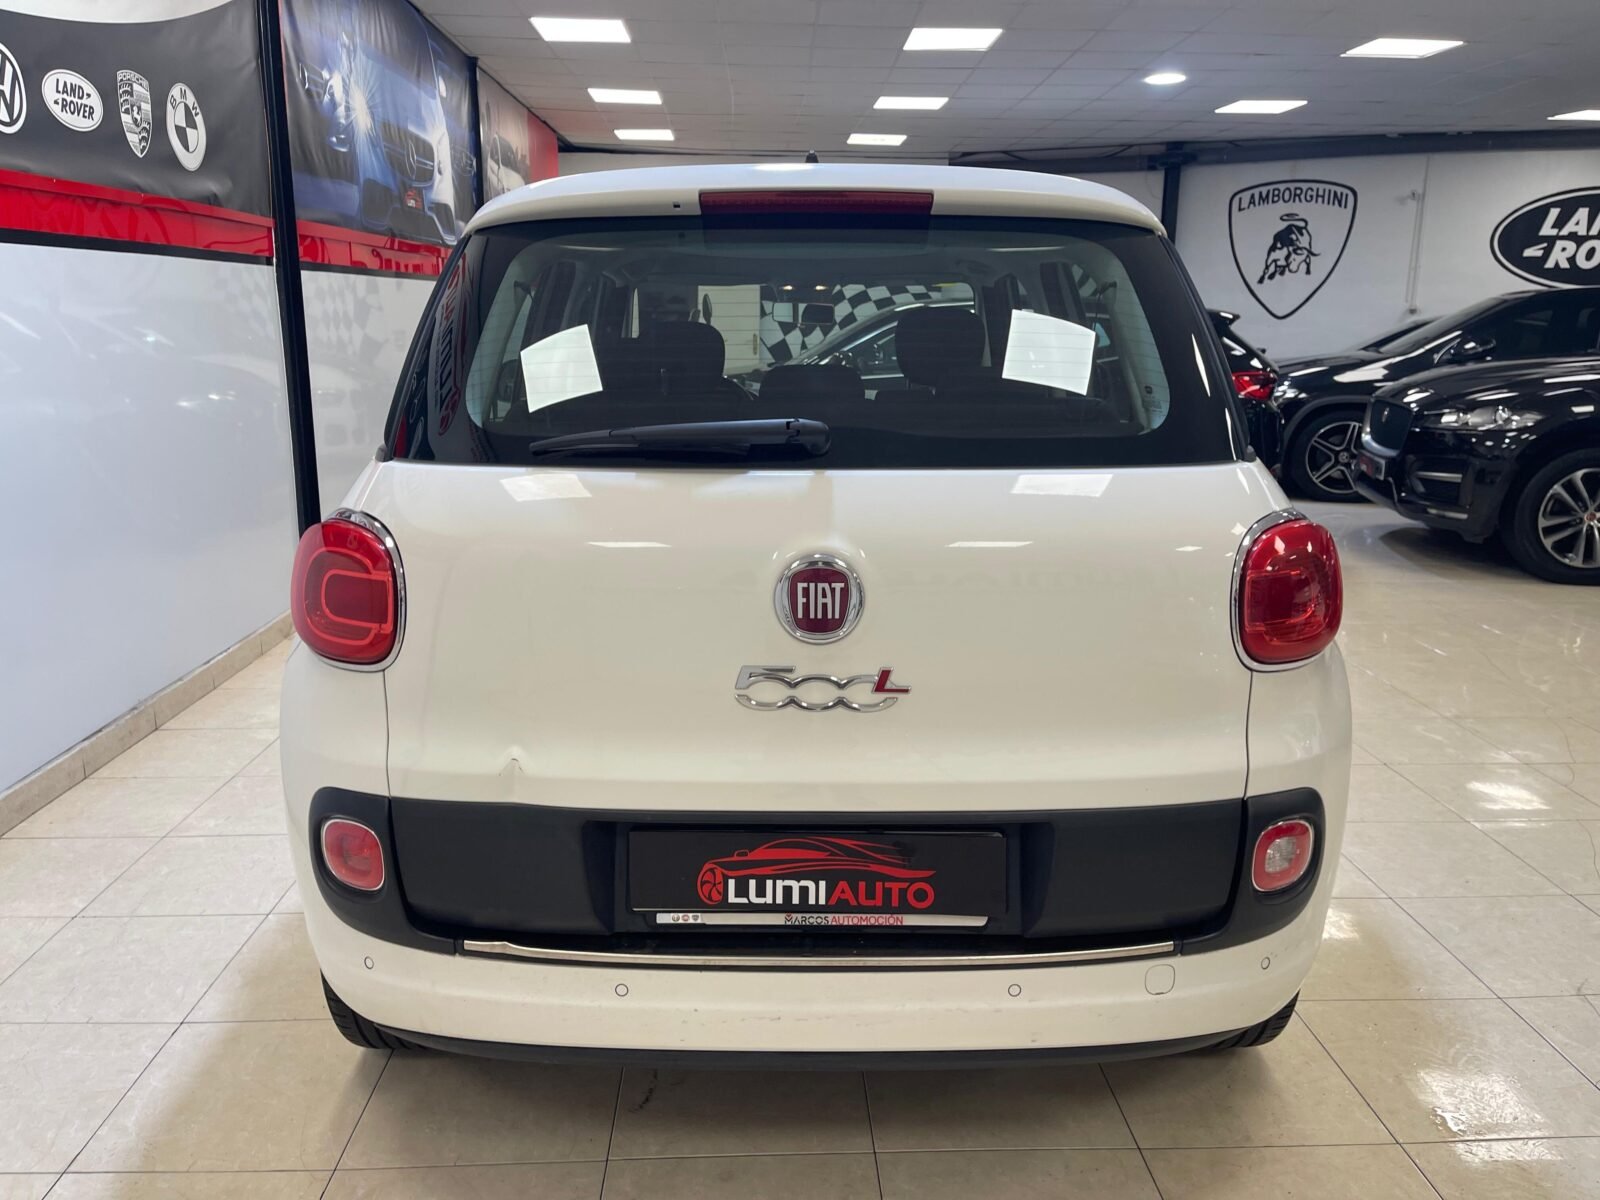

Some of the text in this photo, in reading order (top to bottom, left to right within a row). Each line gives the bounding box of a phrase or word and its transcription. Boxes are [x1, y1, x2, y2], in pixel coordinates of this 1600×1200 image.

[55, 78, 85, 101] LAND
[61, 101, 95, 121] ROVER
[169, 87, 200, 118] BMW
[1238, 187, 1349, 212] LAMBORGHINI
[796, 582, 845, 619] FIAT
[734, 665, 912, 713] 500L
[784, 913, 904, 926] MARCOS AUTOMOCIÓN
